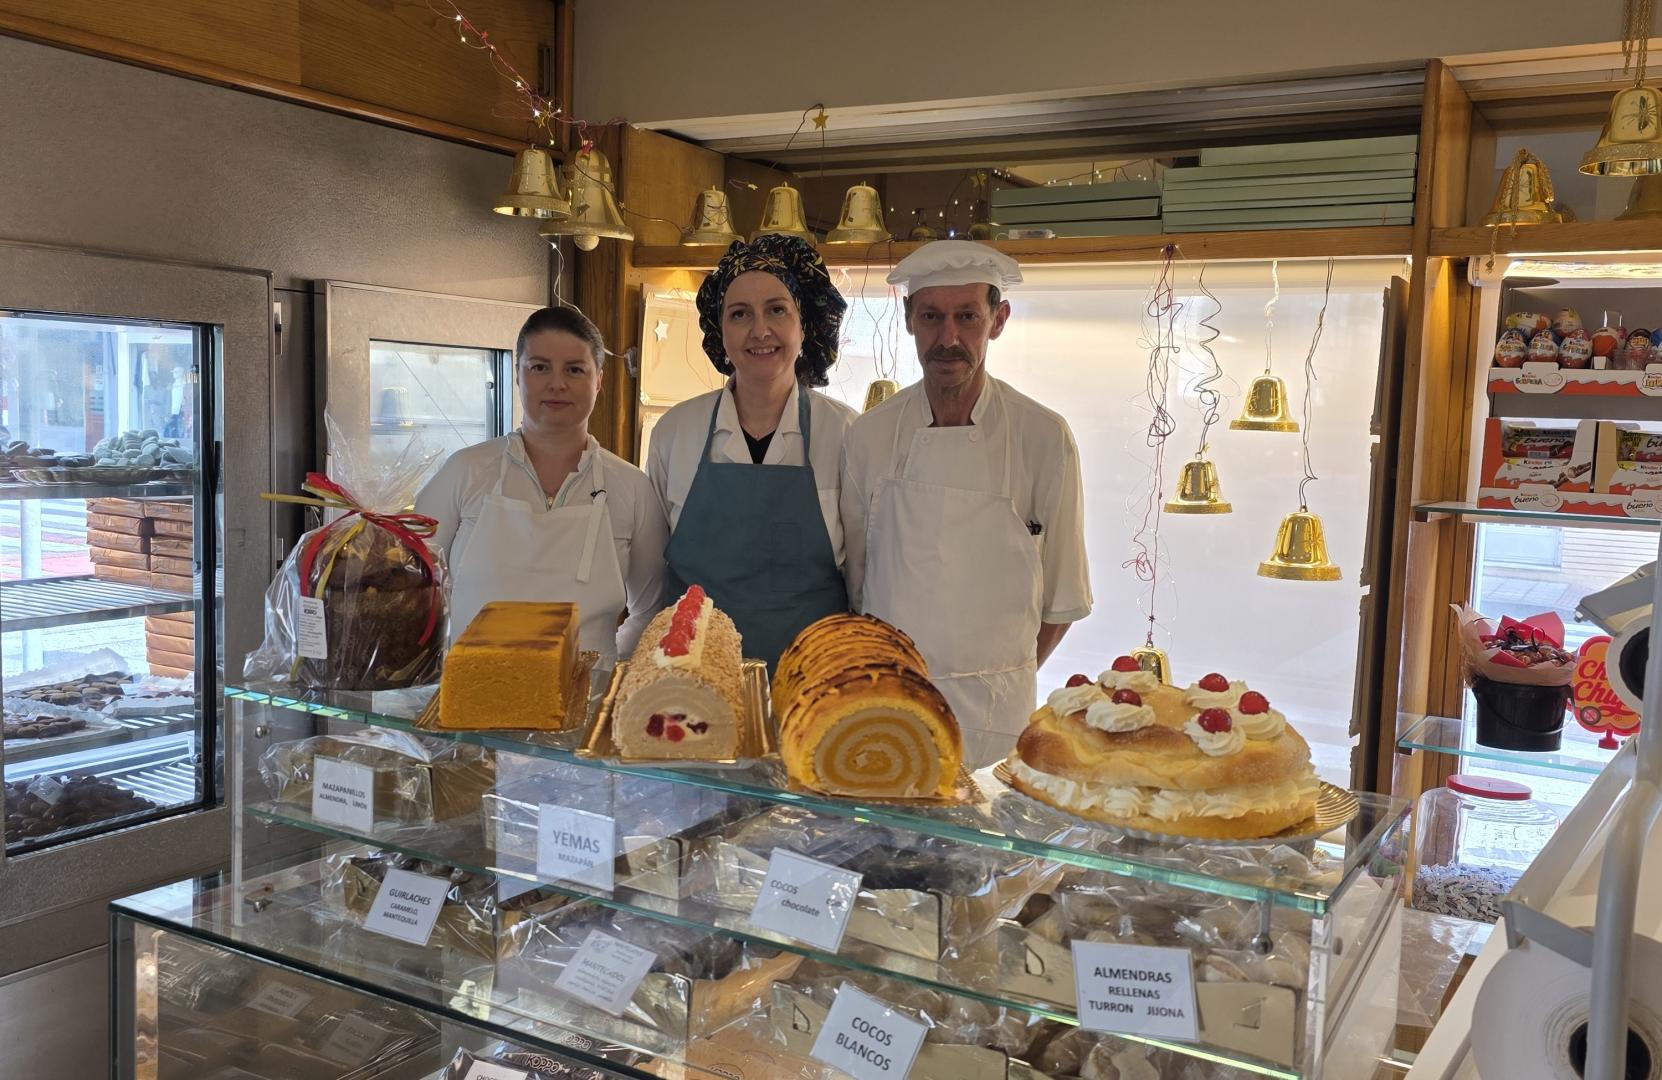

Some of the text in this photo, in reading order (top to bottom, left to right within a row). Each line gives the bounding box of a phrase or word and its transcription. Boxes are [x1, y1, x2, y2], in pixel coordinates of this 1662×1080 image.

[1646, 438, 1662, 448] bu
[1513, 495, 1539, 504] bueno
[1626, 502, 1653, 510] bueno
[553, 830, 600, 854] YEMAS
[770, 879, 799, 895] COCOS
[389, 888, 431, 906] GUIRLACHES
[781, 898, 820, 917] chocolate
[383, 911, 418, 926] MANTEQUILLA
[1094, 966, 1172, 984] ALMENDRAS
[1108, 986, 1160, 1000] RELLENAS
[1088, 1000, 1185, 1018] TURRON JIJONA
[851, 1017, 893, 1046] COCOS
[835, 1032, 892, 1071] BLANCOS
[525, 1054, 561, 1074] KOPPO
